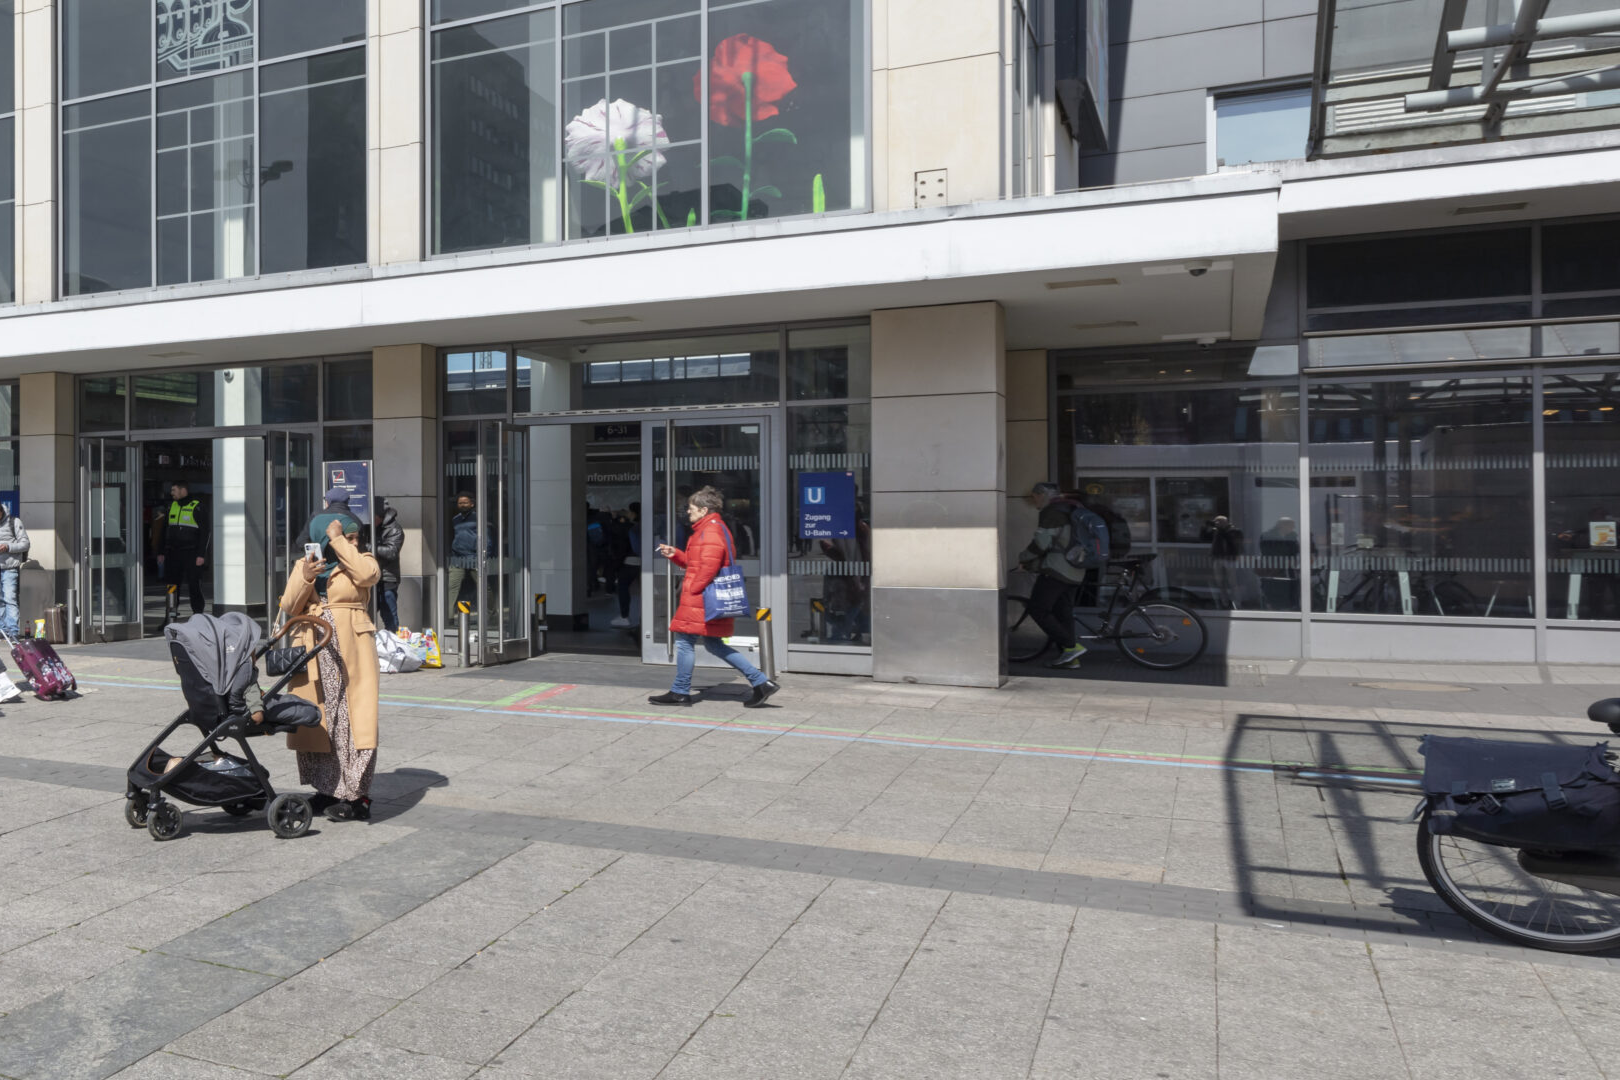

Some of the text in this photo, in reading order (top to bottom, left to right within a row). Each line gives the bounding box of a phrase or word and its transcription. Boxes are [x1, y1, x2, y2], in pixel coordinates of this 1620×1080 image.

[587, 472, 641, 483] nformation
[808, 487, 822, 504] U
[804, 513, 832, 522] Zugang
[804, 529, 832, 537] U-Bahn
